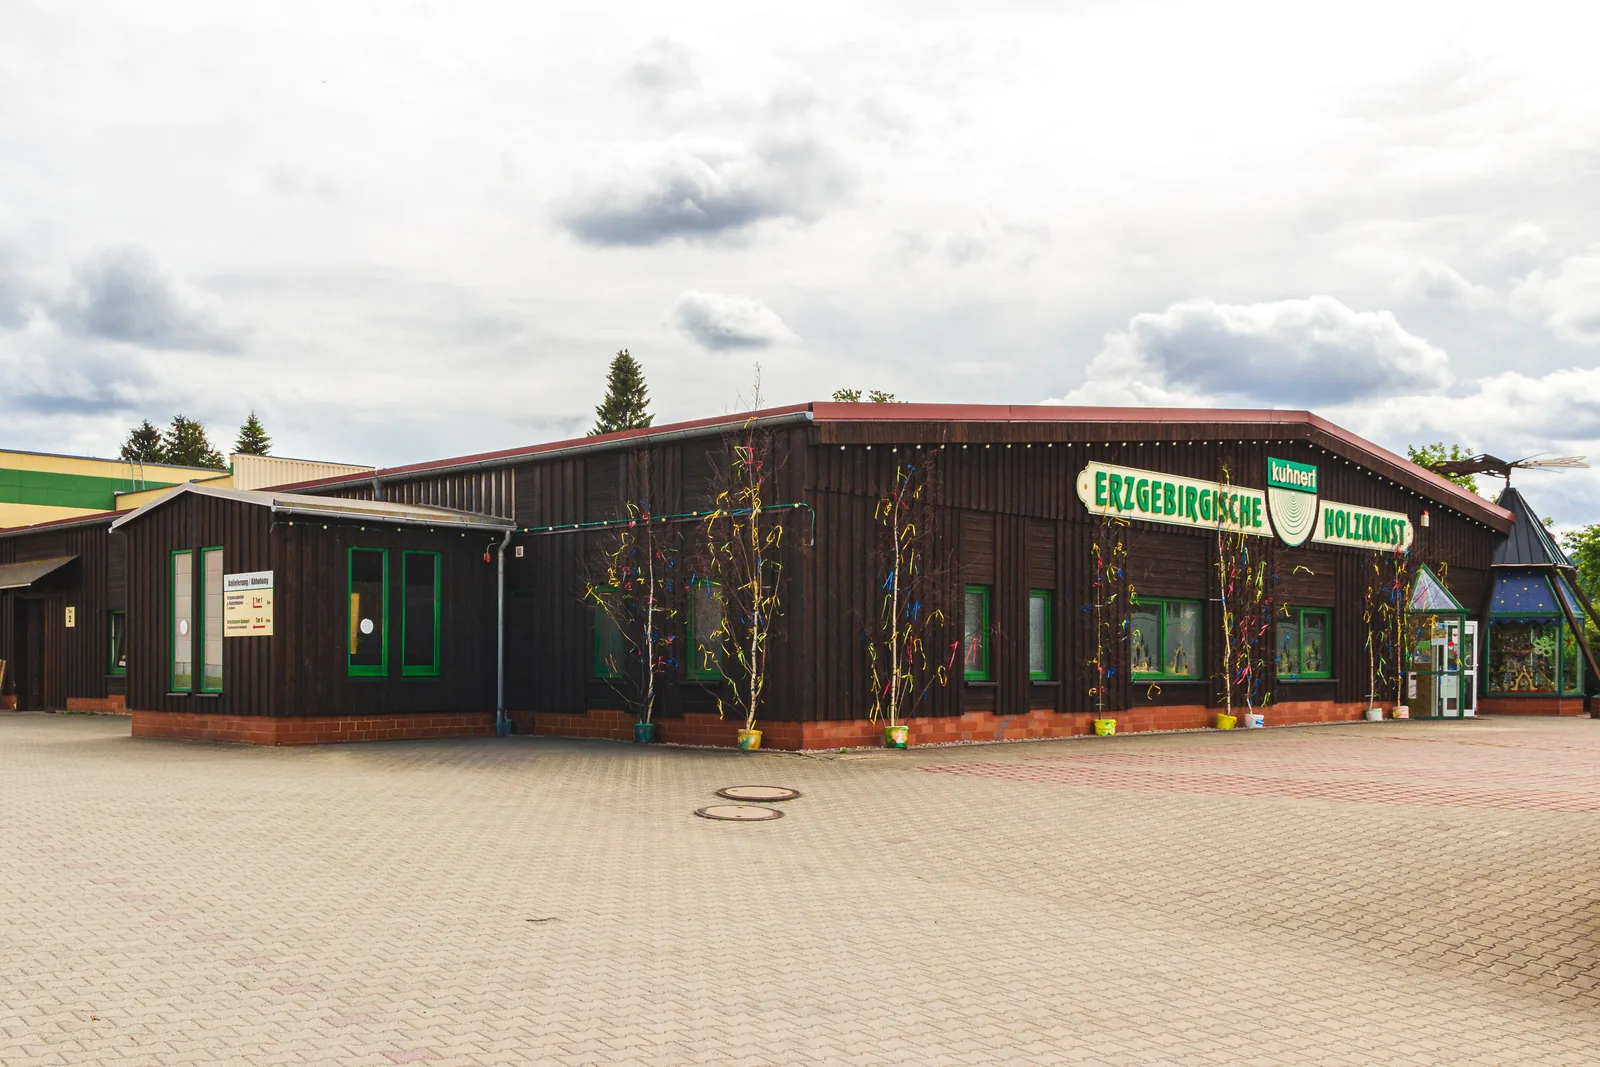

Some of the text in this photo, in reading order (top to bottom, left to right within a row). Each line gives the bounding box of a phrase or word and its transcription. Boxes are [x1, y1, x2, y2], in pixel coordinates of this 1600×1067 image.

[1272, 461, 1317, 488] kuhnert
[1095, 470, 1407, 546] ERZGEBIRGISCHE HOLZKUNST
[228, 579, 248, 587] Anlieferung
[251, 577, 269, 585] Abholung
